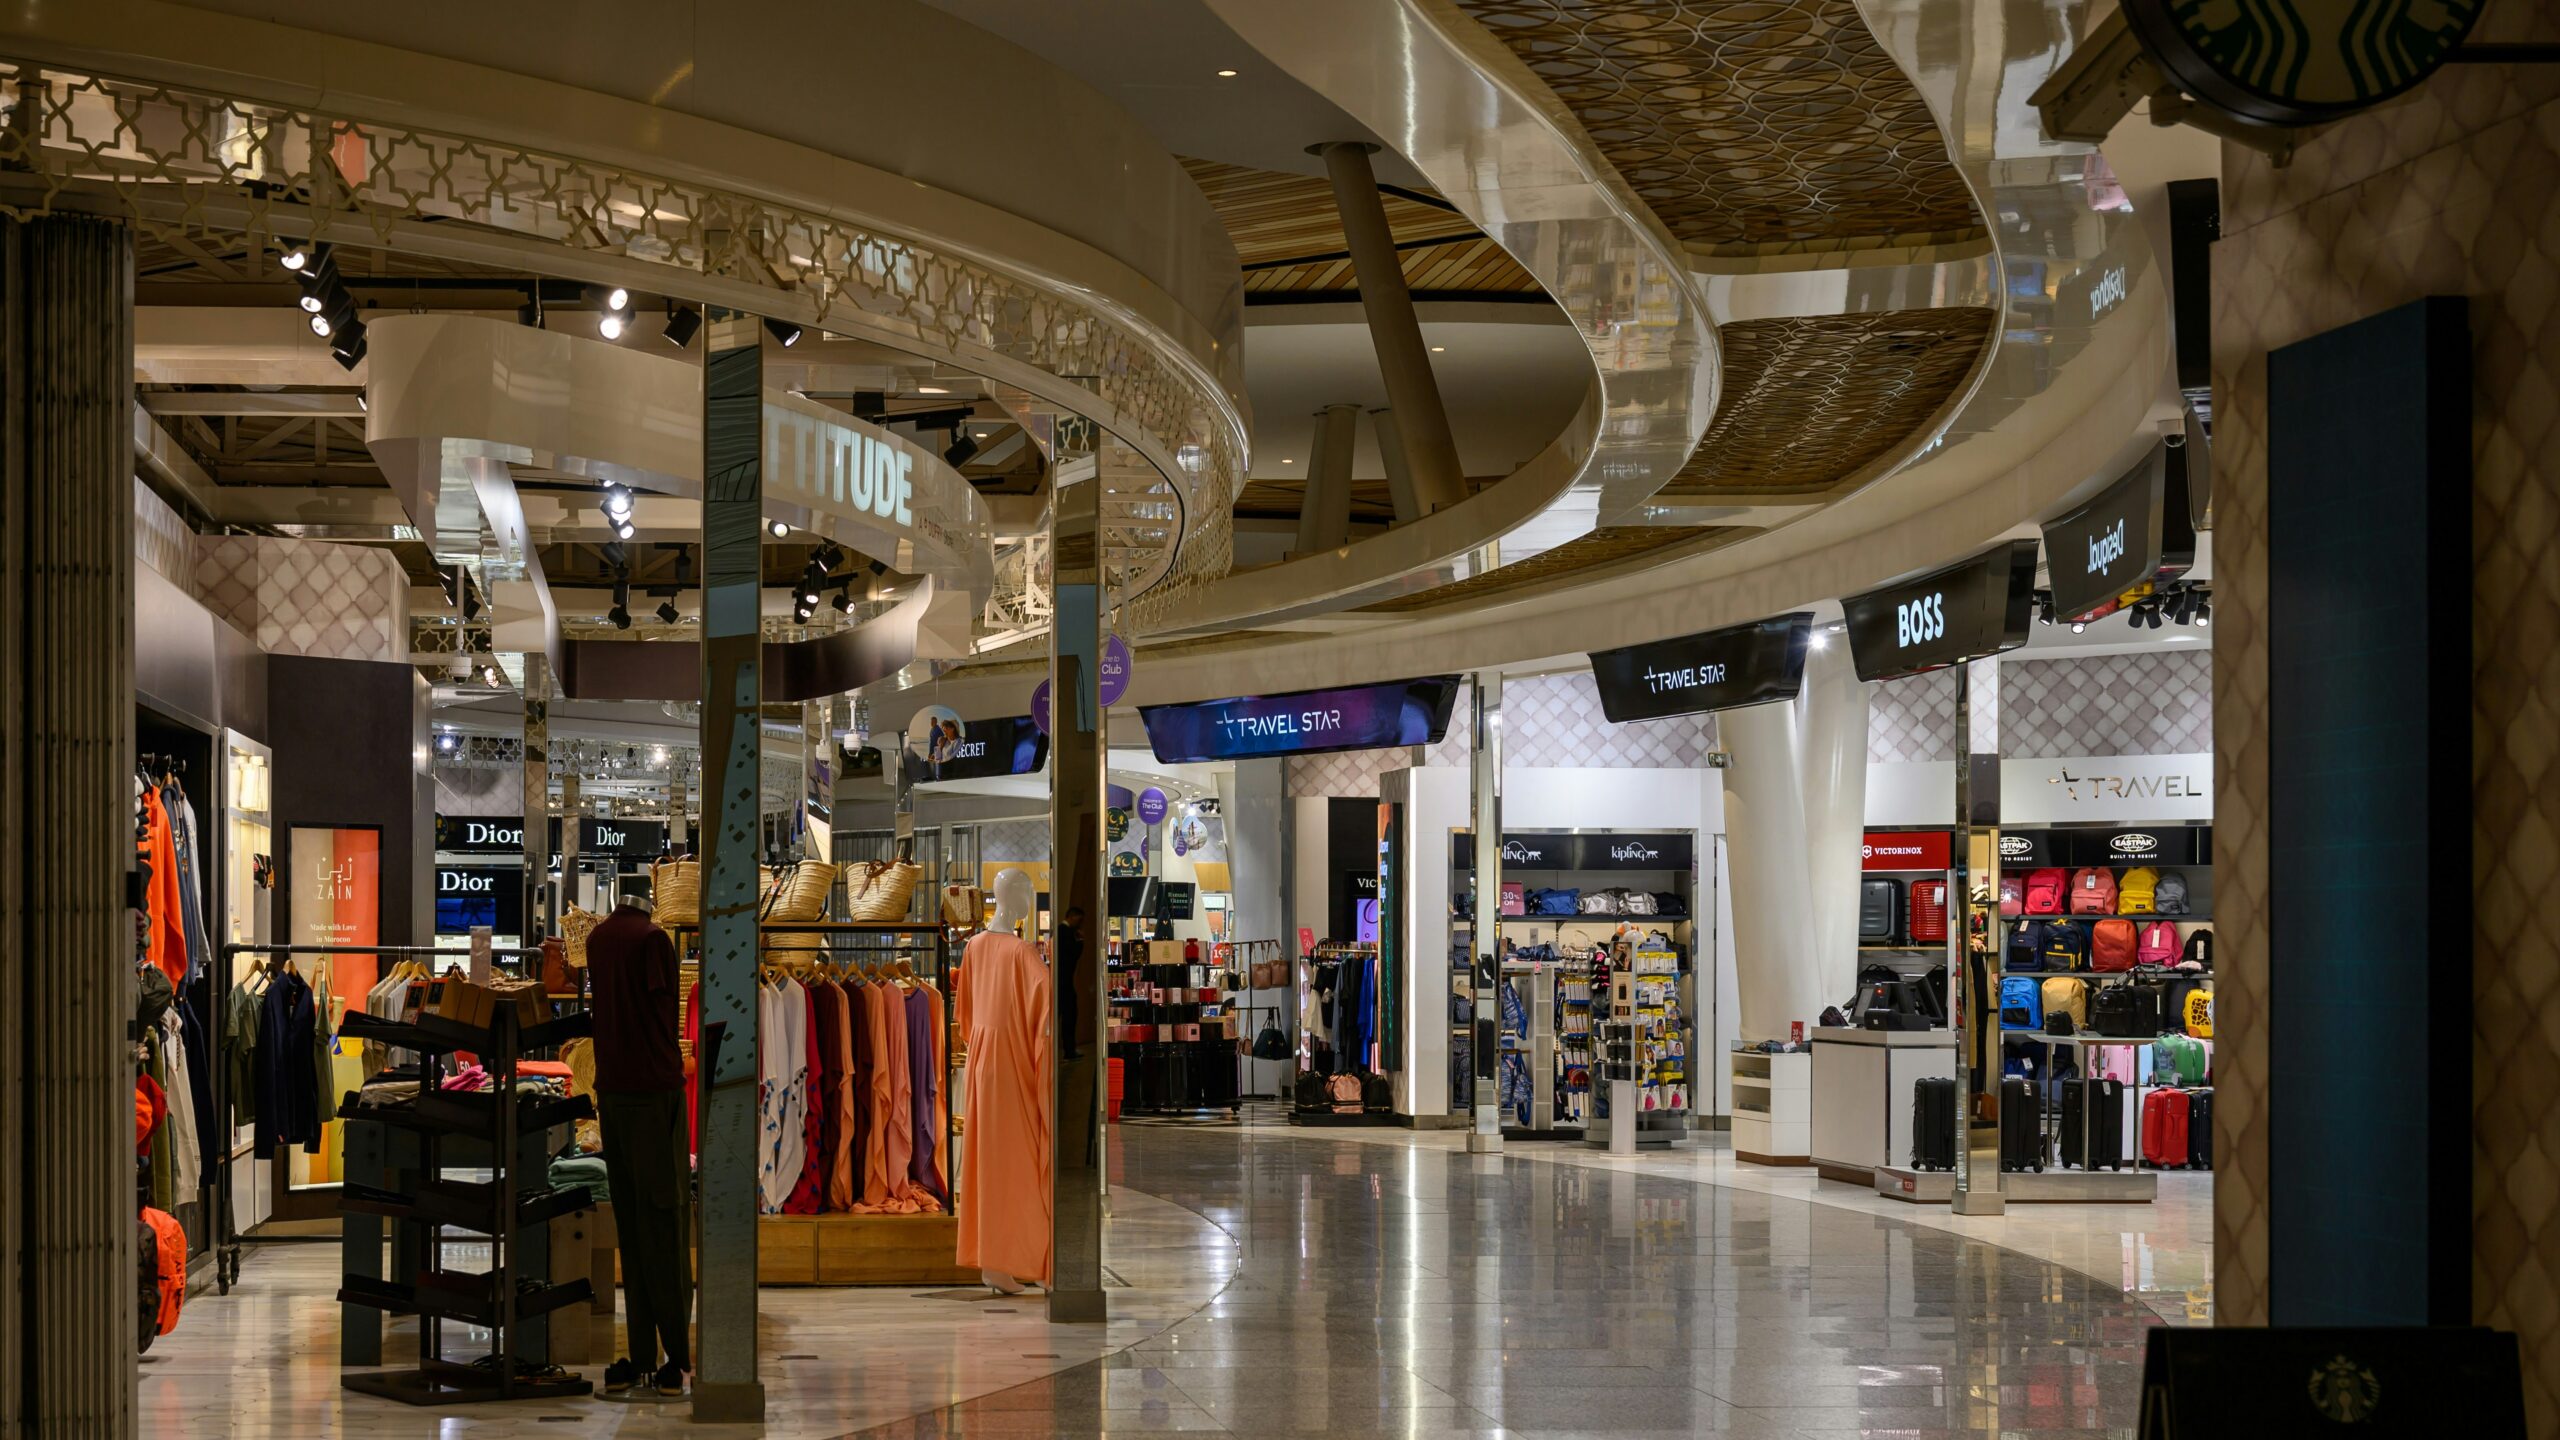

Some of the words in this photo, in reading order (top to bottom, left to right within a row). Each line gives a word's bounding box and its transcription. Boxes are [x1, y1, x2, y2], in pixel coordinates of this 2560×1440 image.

[1898, 592, 1944, 648] BOSS
[1101, 663, 1122, 675] Club
[1658, 669, 1697, 692] TRAVEL
[1700, 663, 1726, 685] STAR
[1237, 714, 1297, 737] TRAVEL
[1302, 709, 1341, 732] STAR
[2087, 775, 2202, 799] TRAVEL
[467, 823, 523, 845] Dior
[596, 826, 626, 846] Dior
[2115, 839, 2153, 847] EASTPAK
[1611, 845, 1645, 862] kipling
[1874, 847, 1922, 855] VICTORINOX
[440, 872, 494, 891] Dior
[317, 885, 352, 900] ZAIN
[501, 955, 519, 963] Dior
